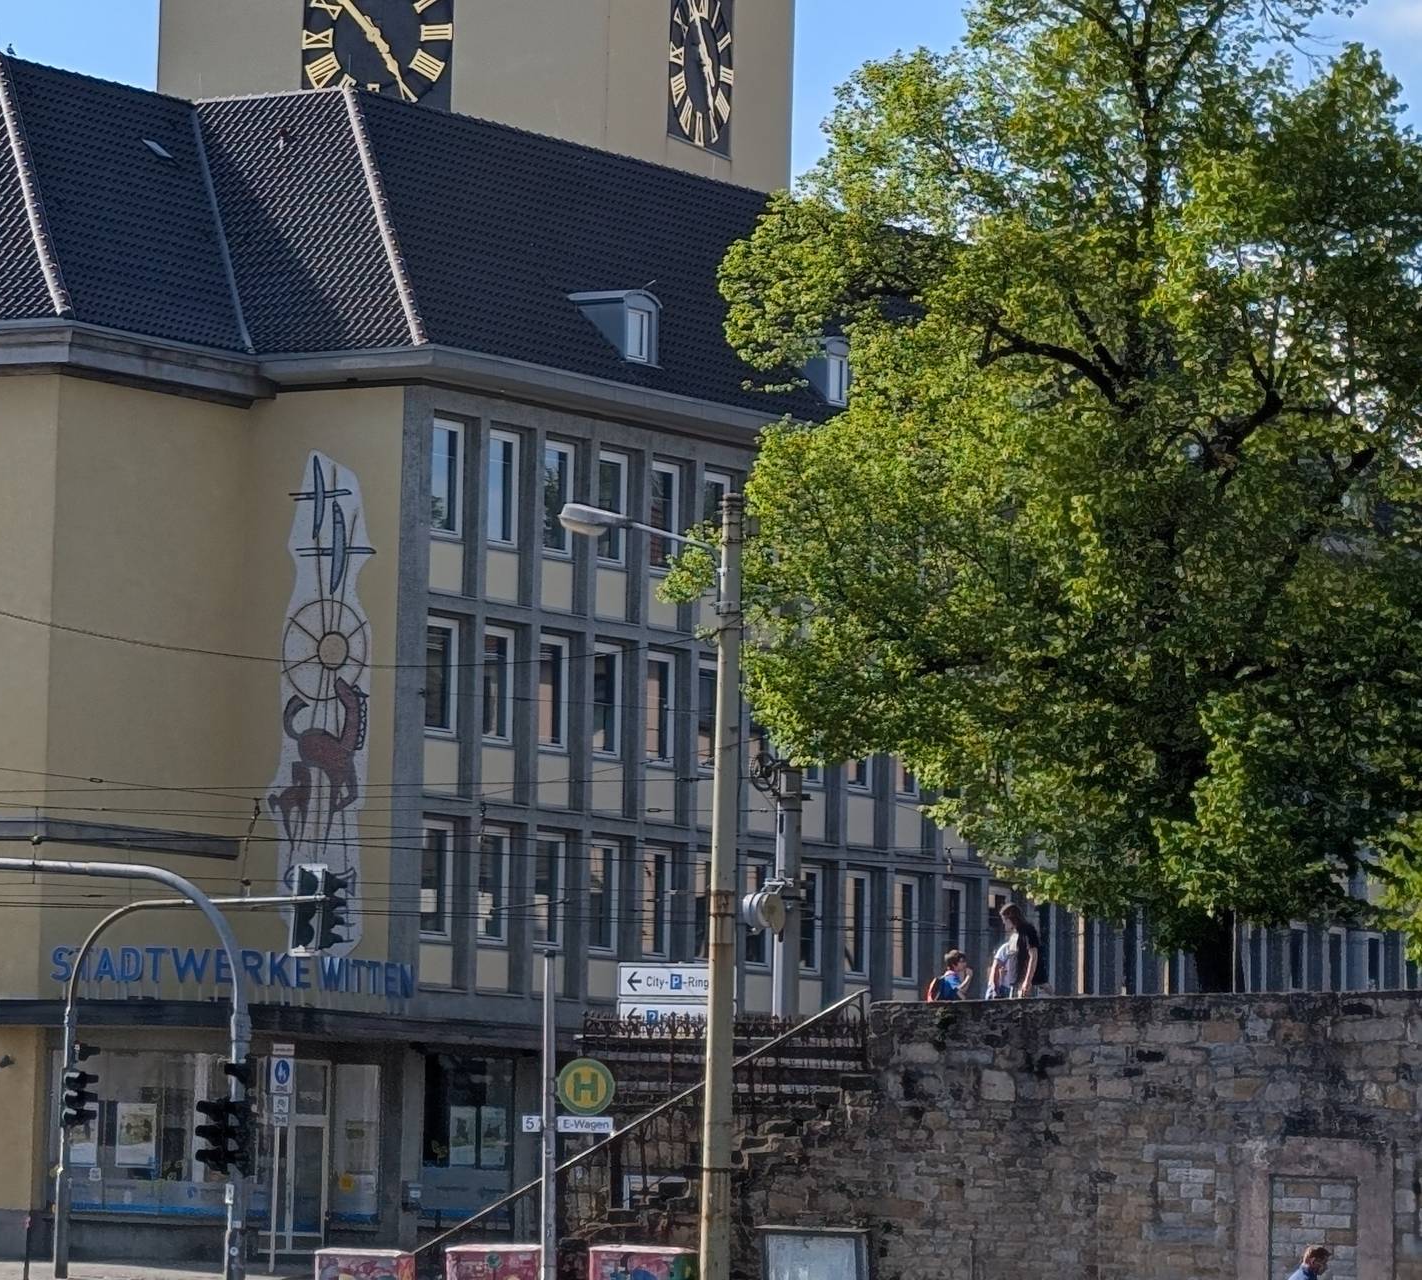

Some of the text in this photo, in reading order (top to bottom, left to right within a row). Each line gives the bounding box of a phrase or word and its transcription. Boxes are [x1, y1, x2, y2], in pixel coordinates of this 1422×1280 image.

[420, 22, 453, 42] III
[719, 65, 734, 88] III
[50, 946, 415, 998] STADTWERKE WITTEN
[573, 1072, 599, 1102] H
[562, 1119, 610, 1132] E-Wagen
